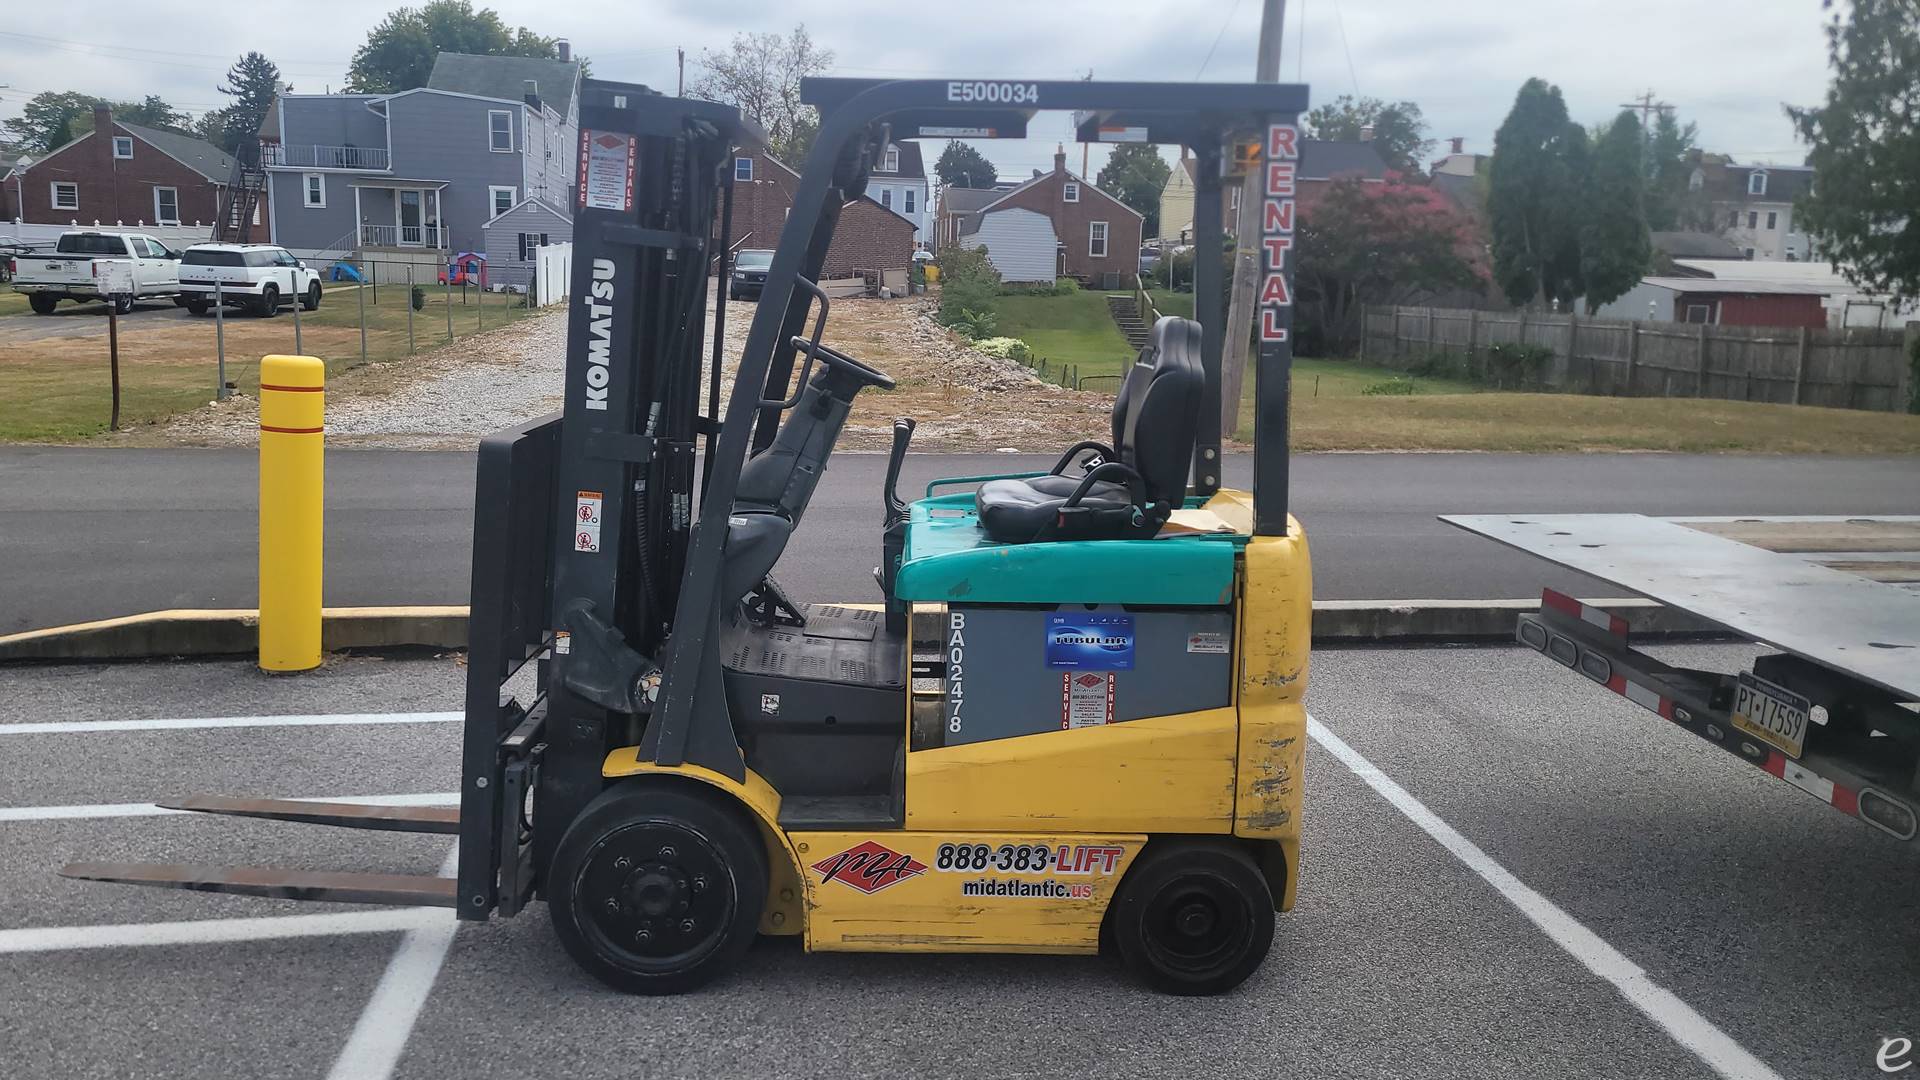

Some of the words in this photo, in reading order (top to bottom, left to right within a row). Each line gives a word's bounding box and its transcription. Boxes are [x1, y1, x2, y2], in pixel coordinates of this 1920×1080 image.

[948, 82, 1039, 103] E500034
[580, 131, 590, 202] SERVICE
[626, 137, 636, 207] RENTALS
[1261, 125, 1298, 341] RENTAL
[584, 258, 616, 411] KOMATSU
[949, 612, 965, 733] BA02478
[1107, 674, 1115, 723] RENTA
[963, 879, 1092, 898] midatlantic.us
